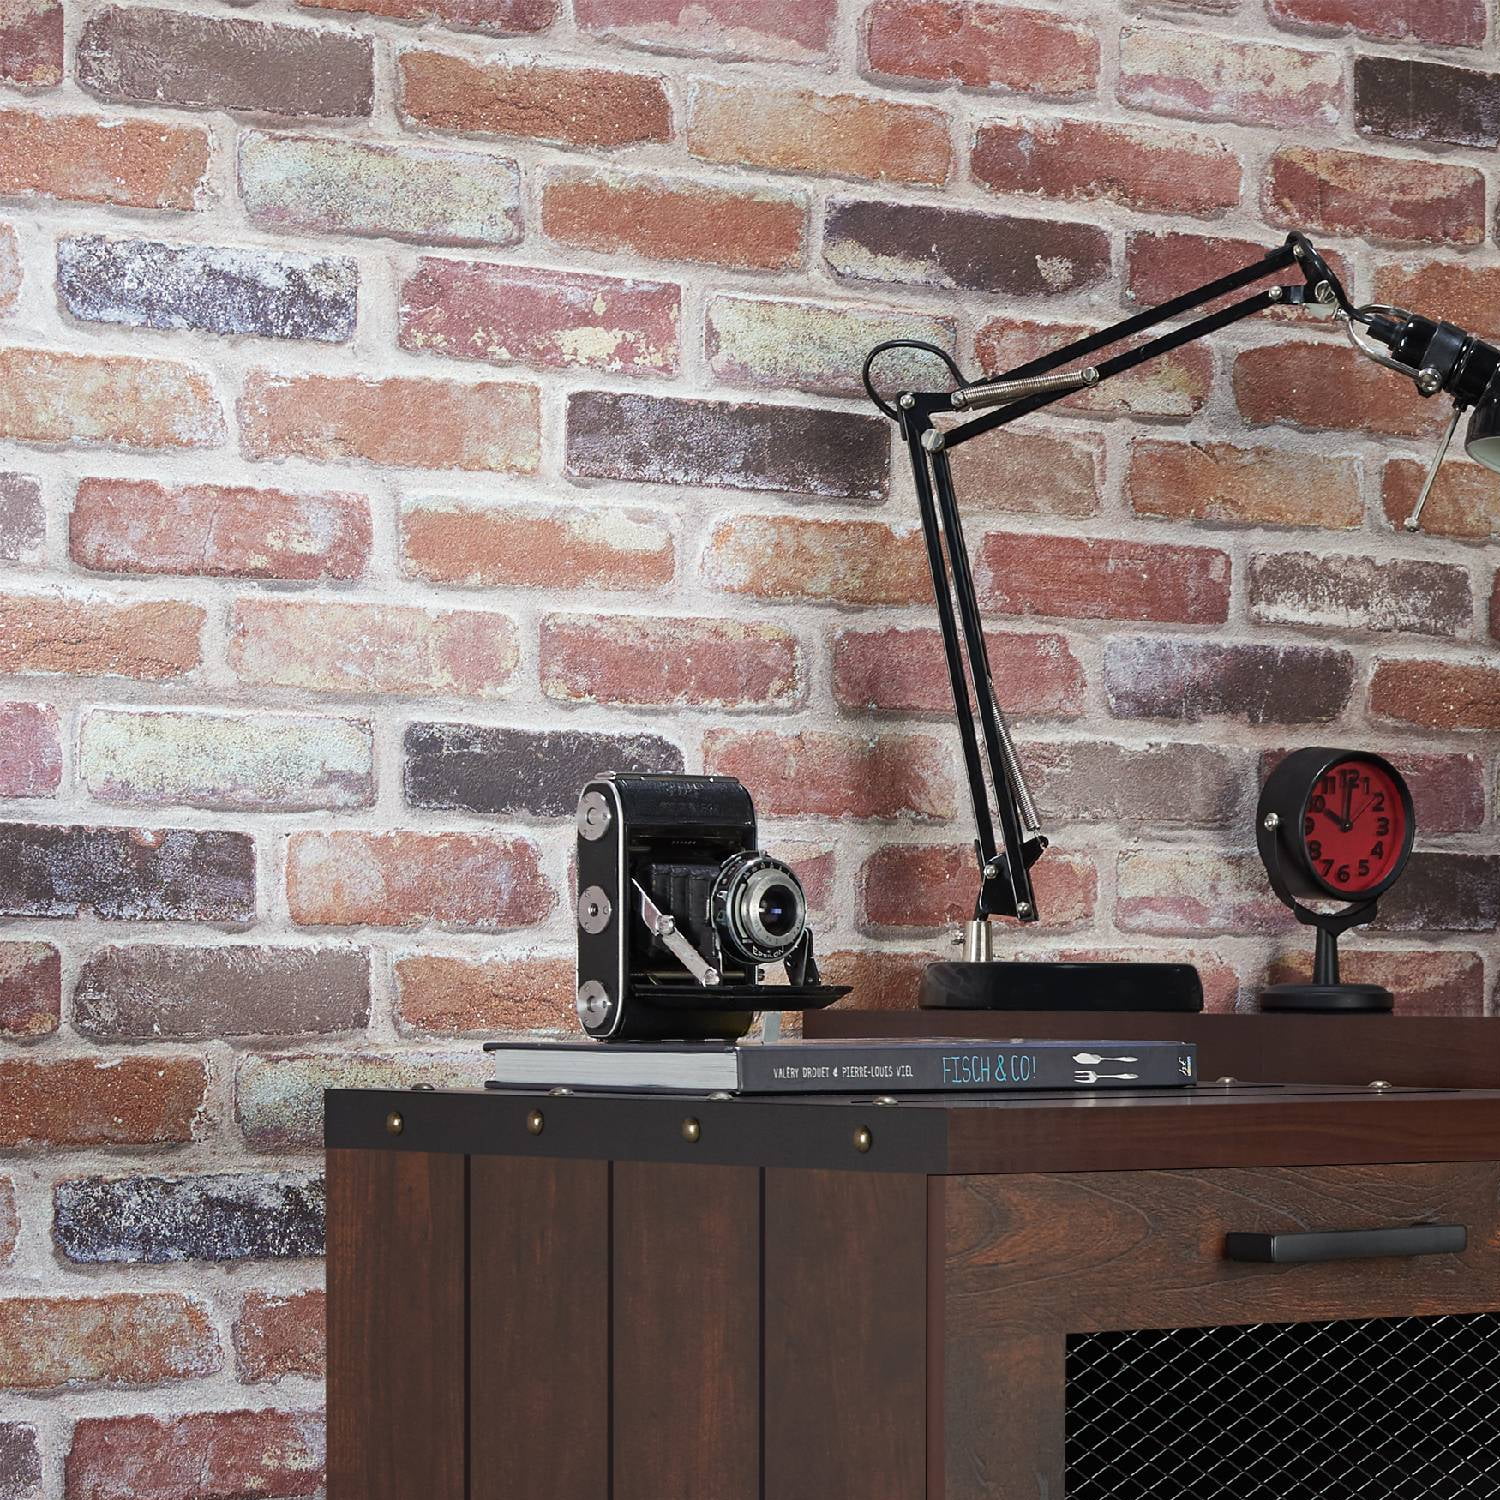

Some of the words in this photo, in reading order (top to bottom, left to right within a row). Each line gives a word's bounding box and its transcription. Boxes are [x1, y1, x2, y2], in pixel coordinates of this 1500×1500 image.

[1363, 776, 1370, 795] 1
[1373, 792, 1384, 812] 2
[1376, 816, 1389, 836] 3
[1309, 840, 1322, 861] 8
[1371, 841, 1383, 859] 4
[1321, 859, 1334, 877] 7
[1337, 864, 1350, 883] 6
[1358, 859, 1370, 876] 5
[802, 1066, 830, 1079] DROUET
[842, 1065, 893, 1079] PIERRE-LOUIS
[896, 1064, 914, 1078] VIEL
[942, 1055, 990, 1084] FISCH
[994, 1054, 1007, 1082] &
[1010, 1055, 1037, 1082] CO!
